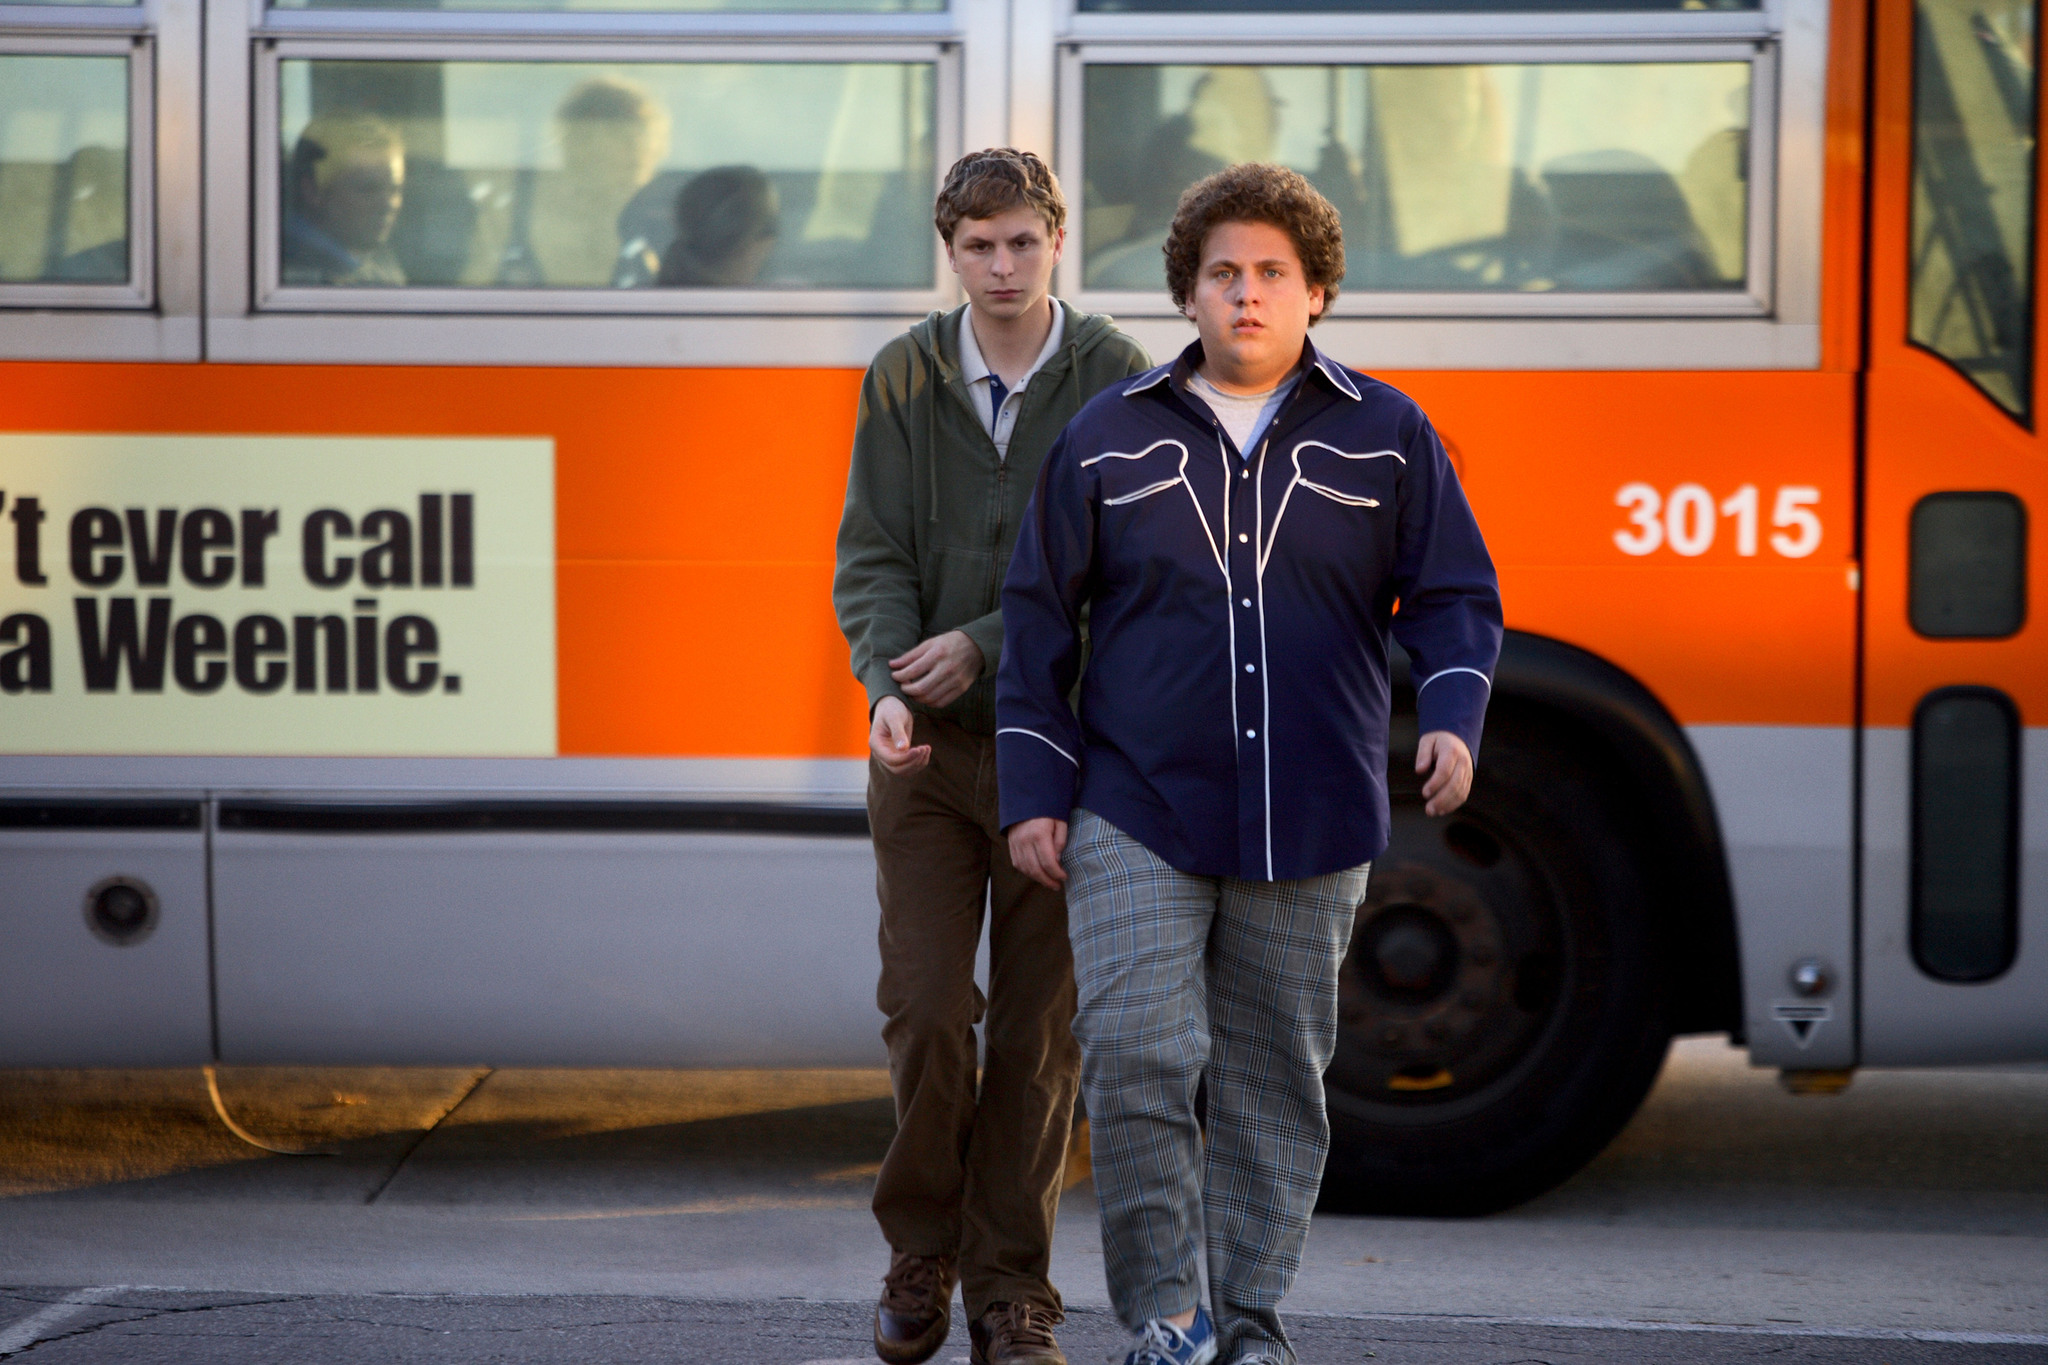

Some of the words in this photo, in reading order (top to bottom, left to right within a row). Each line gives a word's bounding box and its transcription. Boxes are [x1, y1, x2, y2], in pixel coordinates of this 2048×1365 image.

[0, 490, 48, 588] t
[69, 506, 279, 589] ever
[301, 493, 474, 589] call
[1614, 483, 1823, 558] 3015
[0, 612, 53, 696] a
[74, 597, 462, 695] Weenie.
